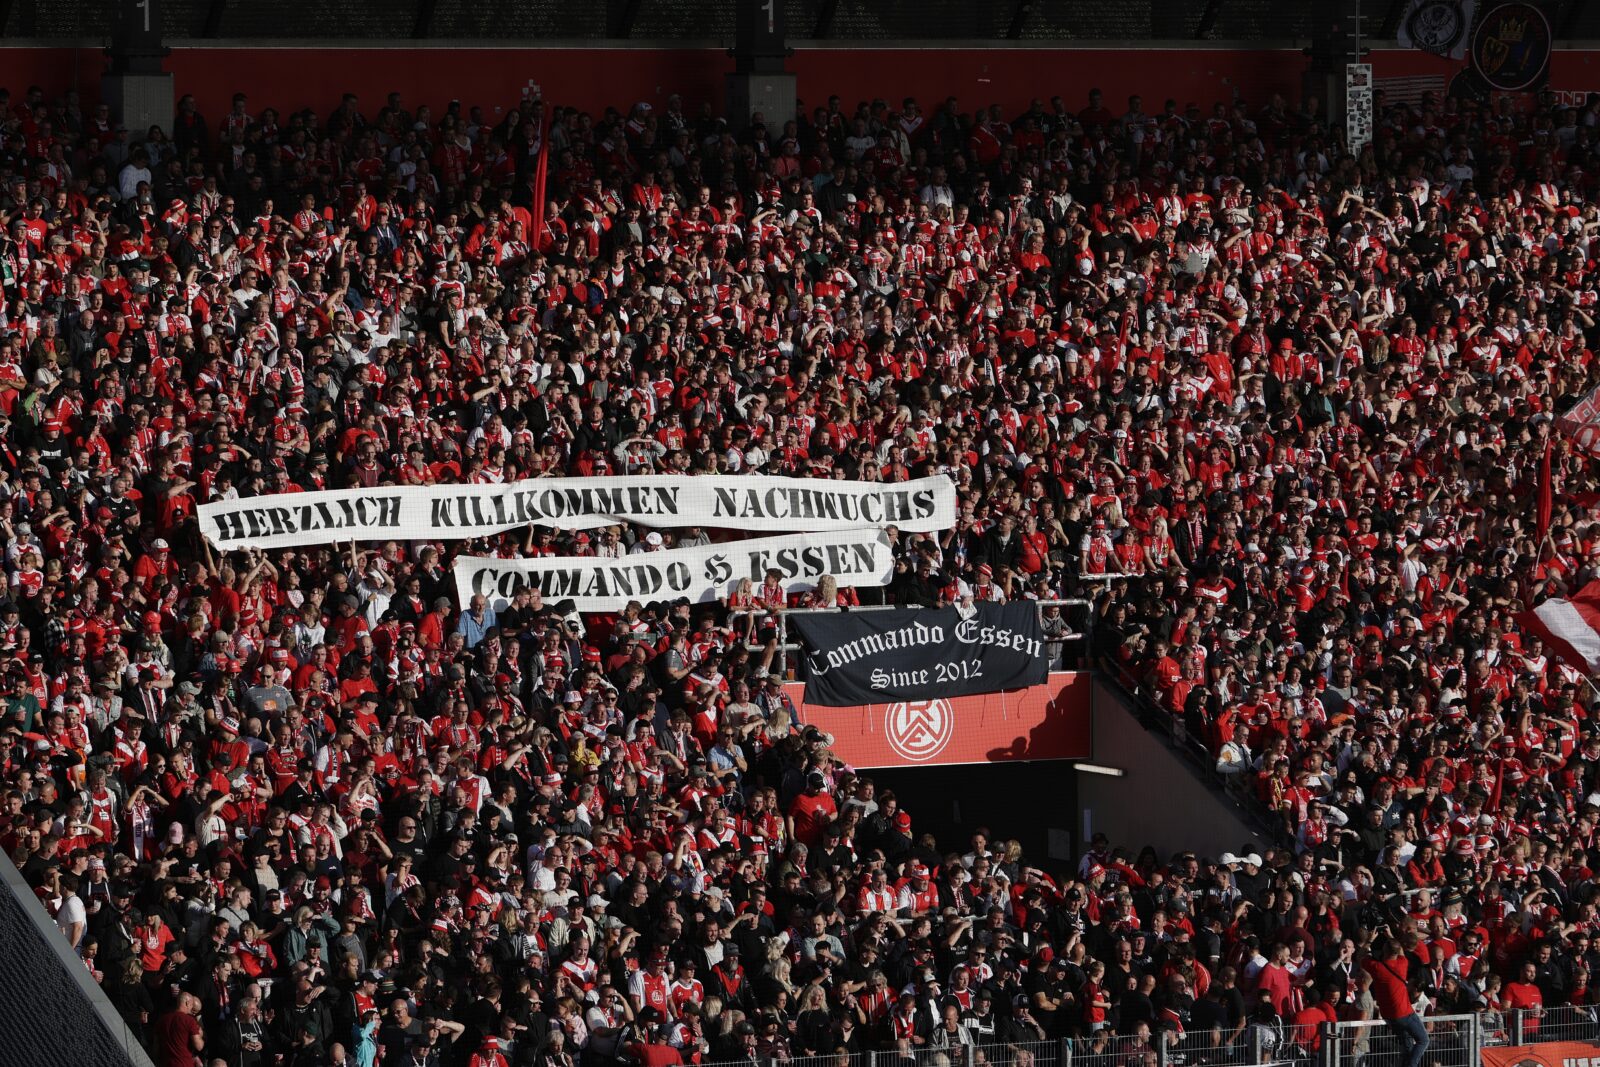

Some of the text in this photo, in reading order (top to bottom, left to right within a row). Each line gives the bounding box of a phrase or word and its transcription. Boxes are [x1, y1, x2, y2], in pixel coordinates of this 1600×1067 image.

[212, 485, 936, 541] HERZLICH WILLKOMMEN NACHWUCHS
[472, 561, 692, 598] COMMANDO
[748, 543, 876, 582] ESSEN
[807, 619, 1043, 676] Commando Essen
[870, 658, 983, 690] Since 2012
